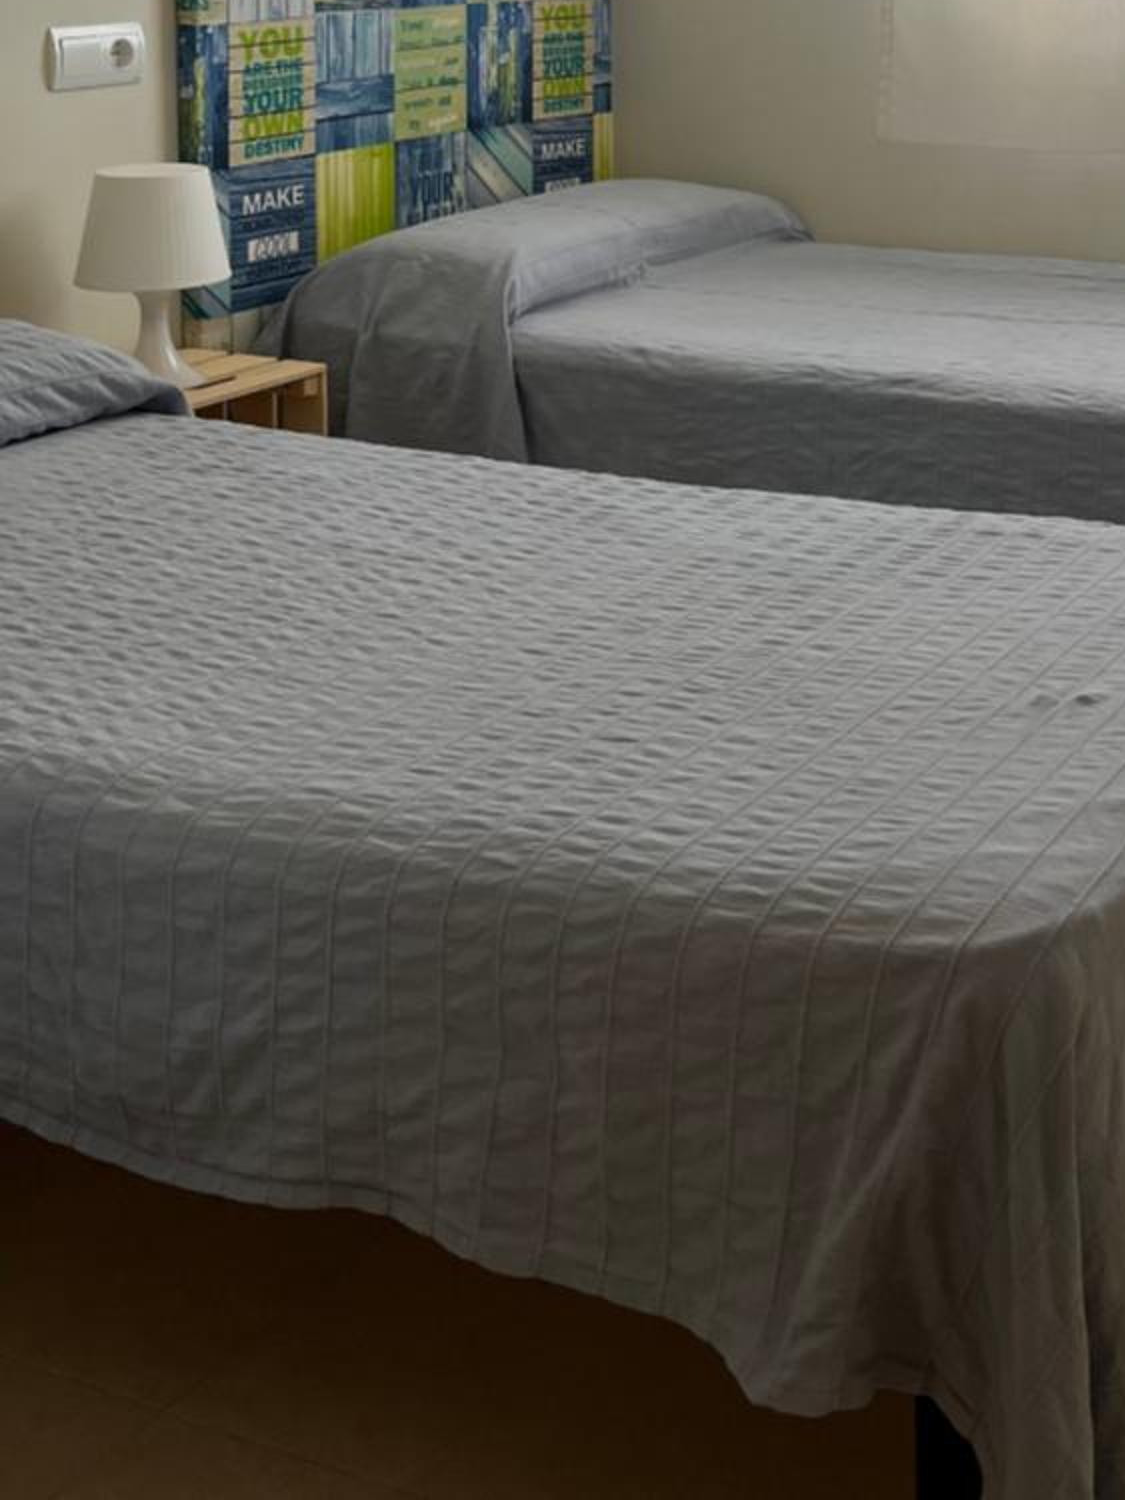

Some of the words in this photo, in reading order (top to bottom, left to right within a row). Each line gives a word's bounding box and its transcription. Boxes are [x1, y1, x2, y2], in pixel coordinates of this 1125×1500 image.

[237, 25, 304, 68] YOU
[243, 88, 304, 115] YOUR
[243, 108, 304, 140] OWN
[243, 133, 305, 159] DESTINY
[541, 136, 586, 161] MAKE
[241, 184, 305, 216] MAKE
